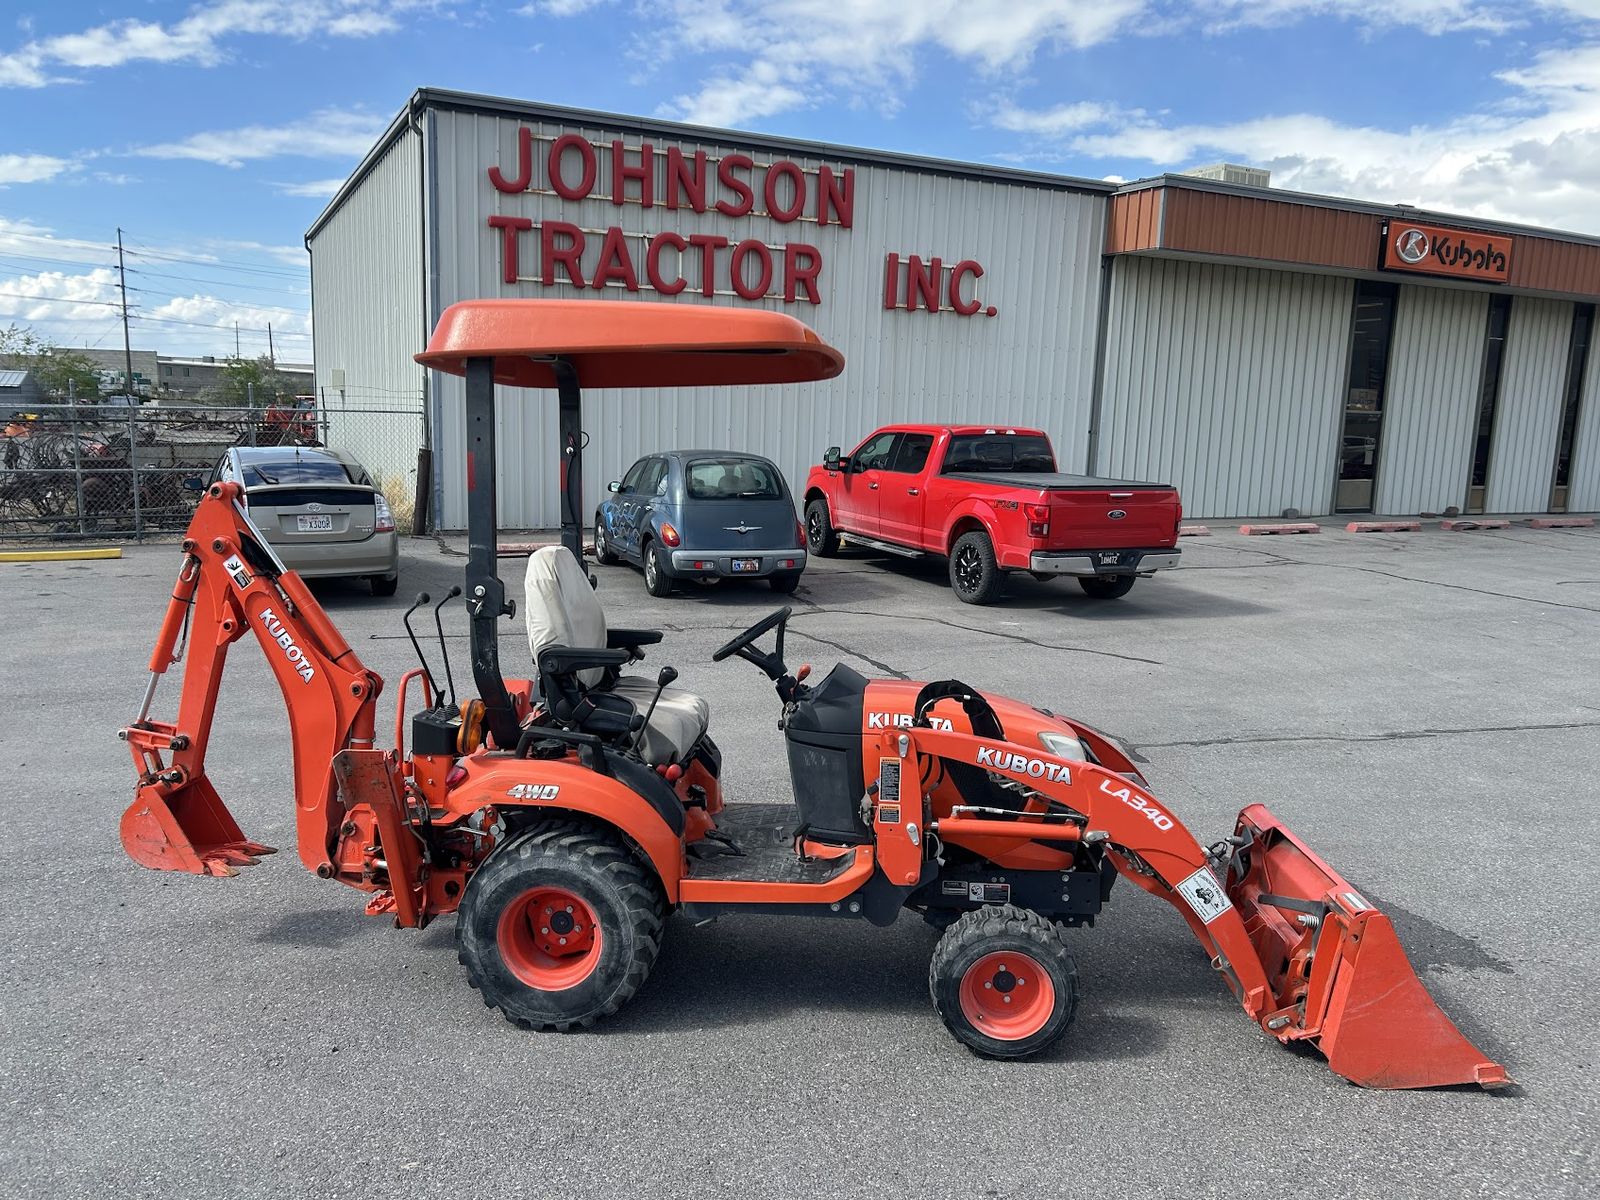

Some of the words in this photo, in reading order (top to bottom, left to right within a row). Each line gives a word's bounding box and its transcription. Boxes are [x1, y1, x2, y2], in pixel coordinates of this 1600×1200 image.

[488, 127, 855, 229] JOHNSON
[487, 215, 823, 305] TRACTOR
[884, 252, 998, 317] INC.
[1430, 235, 1506, 272] Kubota
[258, 607, 315, 684] KUBOTA
[867, 712, 955, 733] KUBTA
[976, 746, 1072, 786] KUBOTA
[506, 783, 560, 801] 4WD
[1099, 779, 1174, 831] LA340
